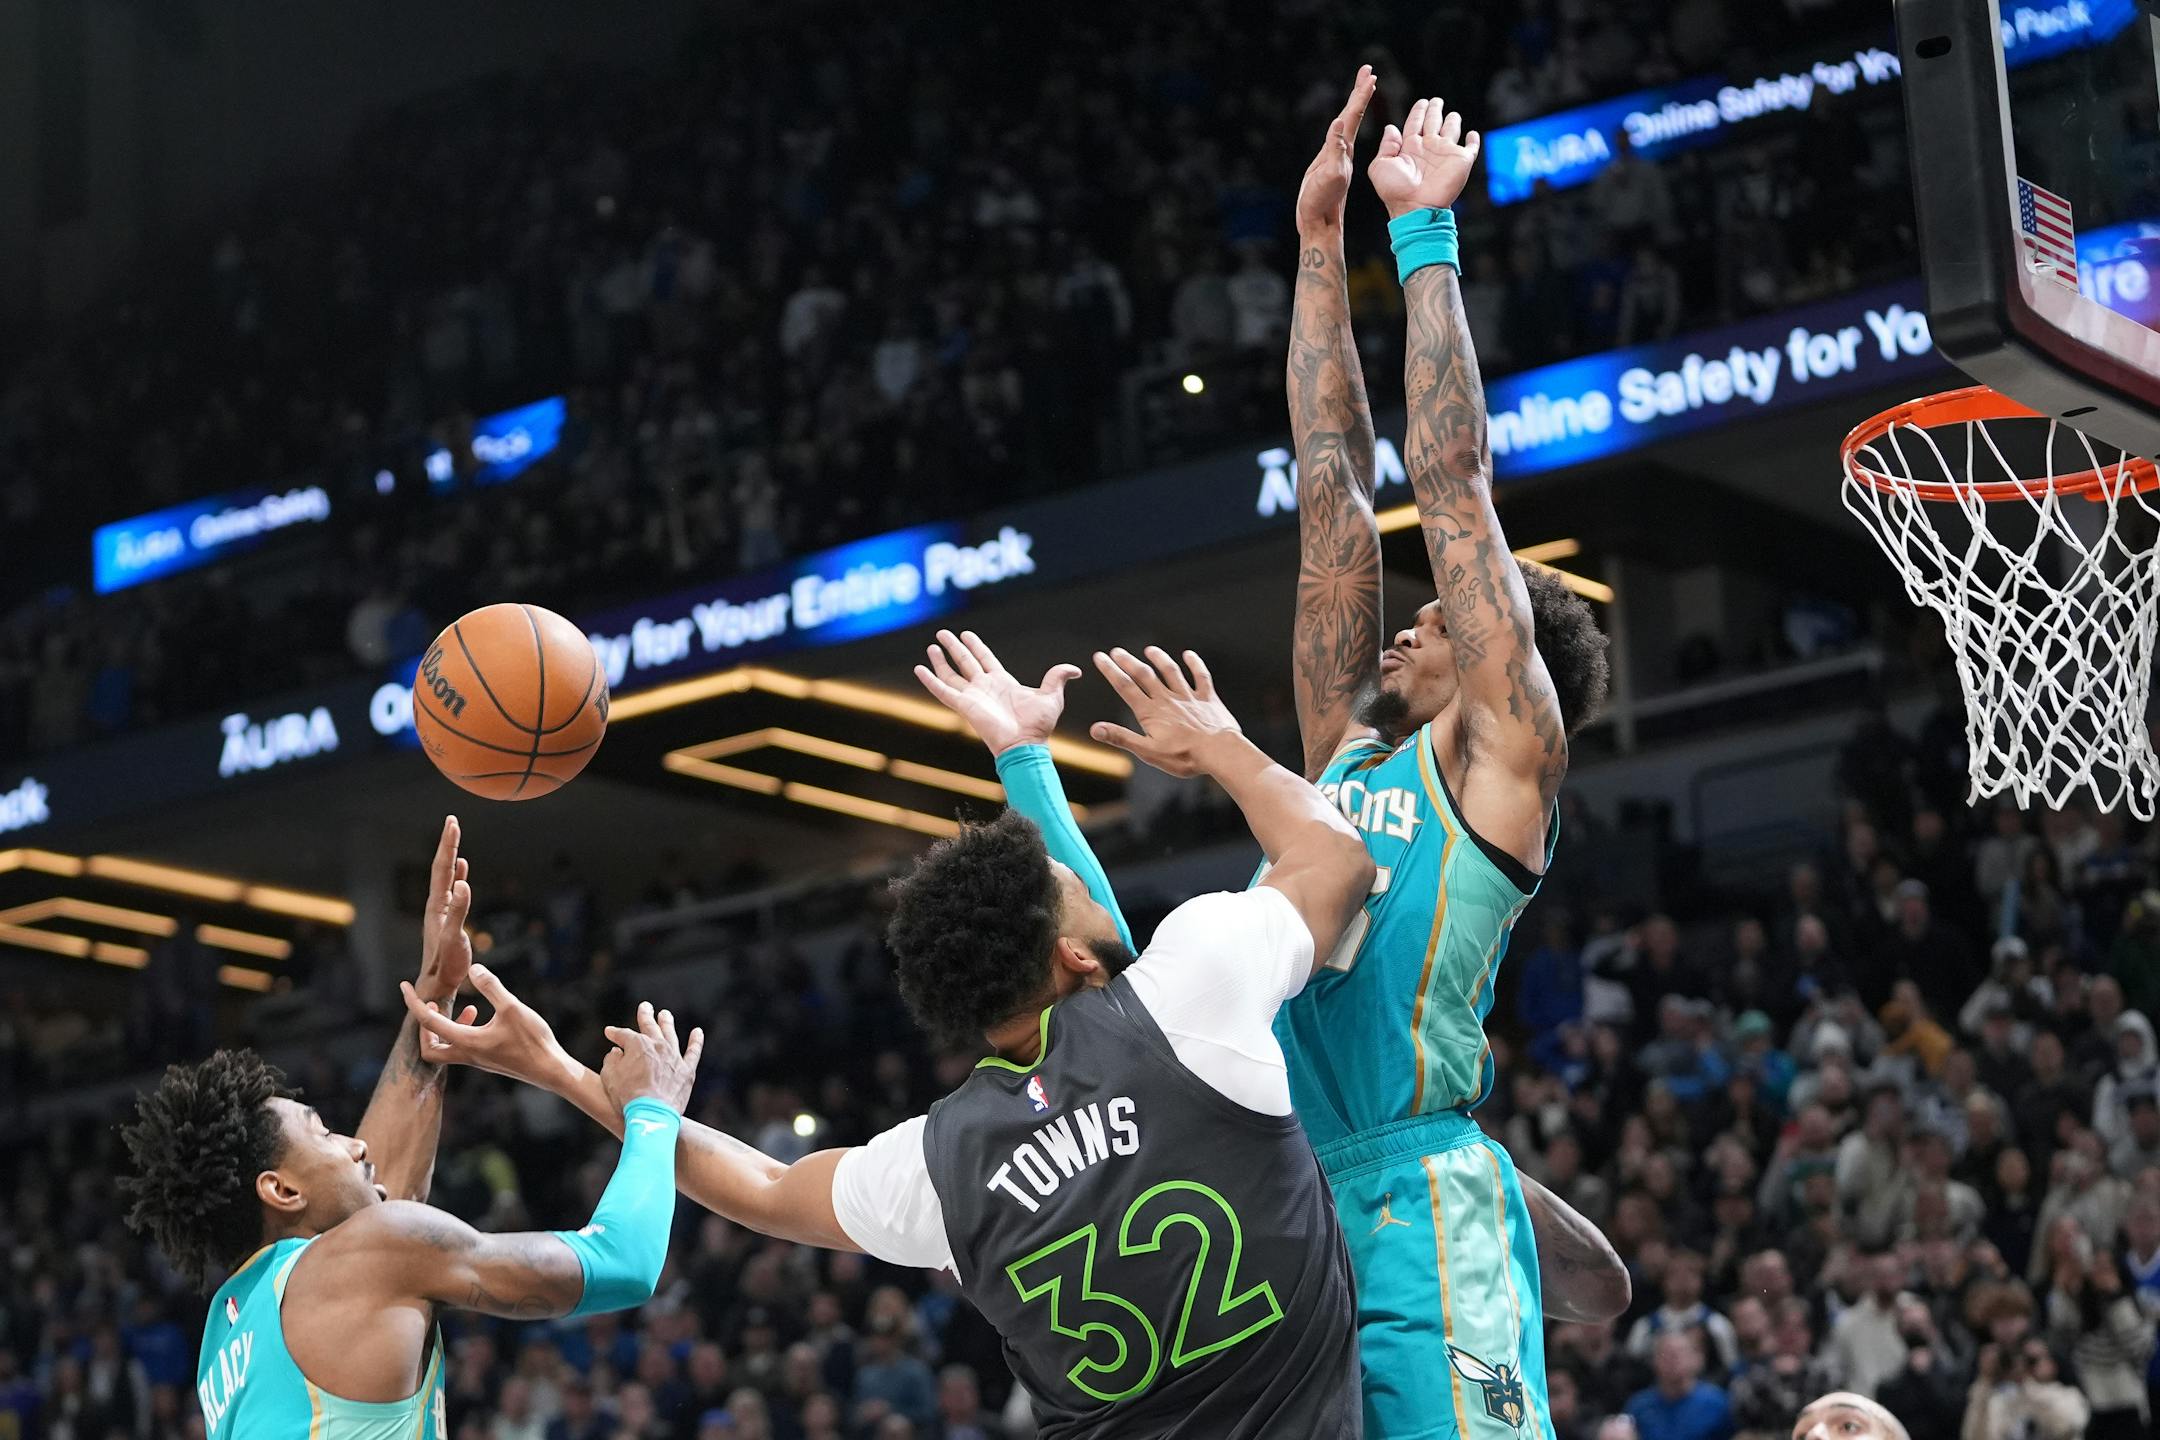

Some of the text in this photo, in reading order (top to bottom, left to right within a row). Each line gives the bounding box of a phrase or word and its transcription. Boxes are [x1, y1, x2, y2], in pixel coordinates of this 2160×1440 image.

[1486, 390, 1614, 456] nline
[1618, 342, 1780, 425] Safety
[1785, 324, 1864, 382] for
[632, 616, 695, 670] for
[692, 597, 791, 652] Your
[790, 560, 921, 630] Entire
[923, 526, 1036, 597] Pack
[986, 1096, 1140, 1213] TOWNS
[1005, 1180, 1284, 1402] 32
